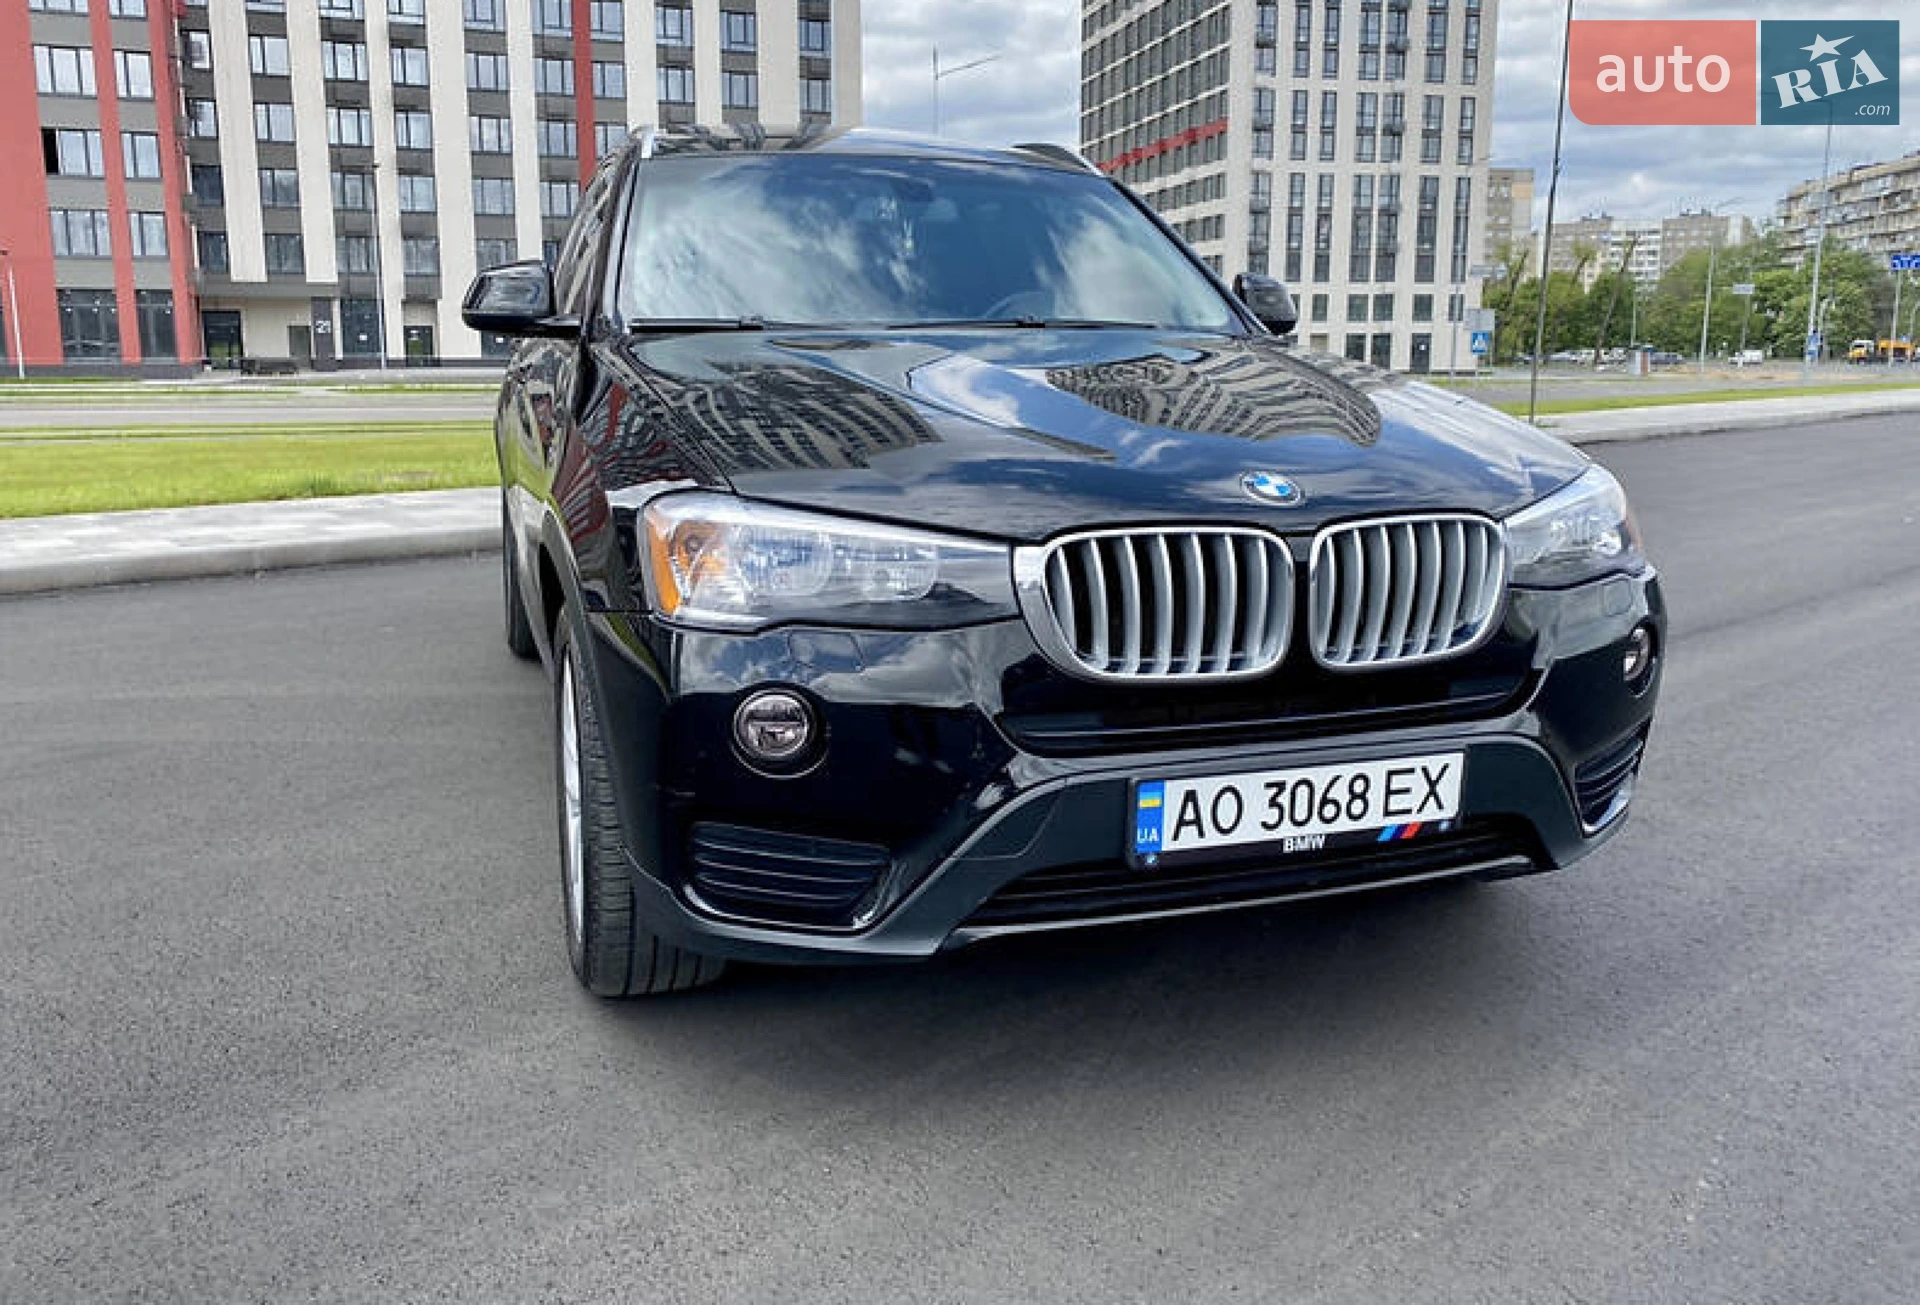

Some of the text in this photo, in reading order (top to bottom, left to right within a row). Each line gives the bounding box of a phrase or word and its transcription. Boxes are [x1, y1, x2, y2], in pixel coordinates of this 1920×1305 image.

[1171, 762, 1449, 842] AO 3068 EX
[1137, 826, 1160, 843] UA
[1283, 834, 1325, 853] BMW
